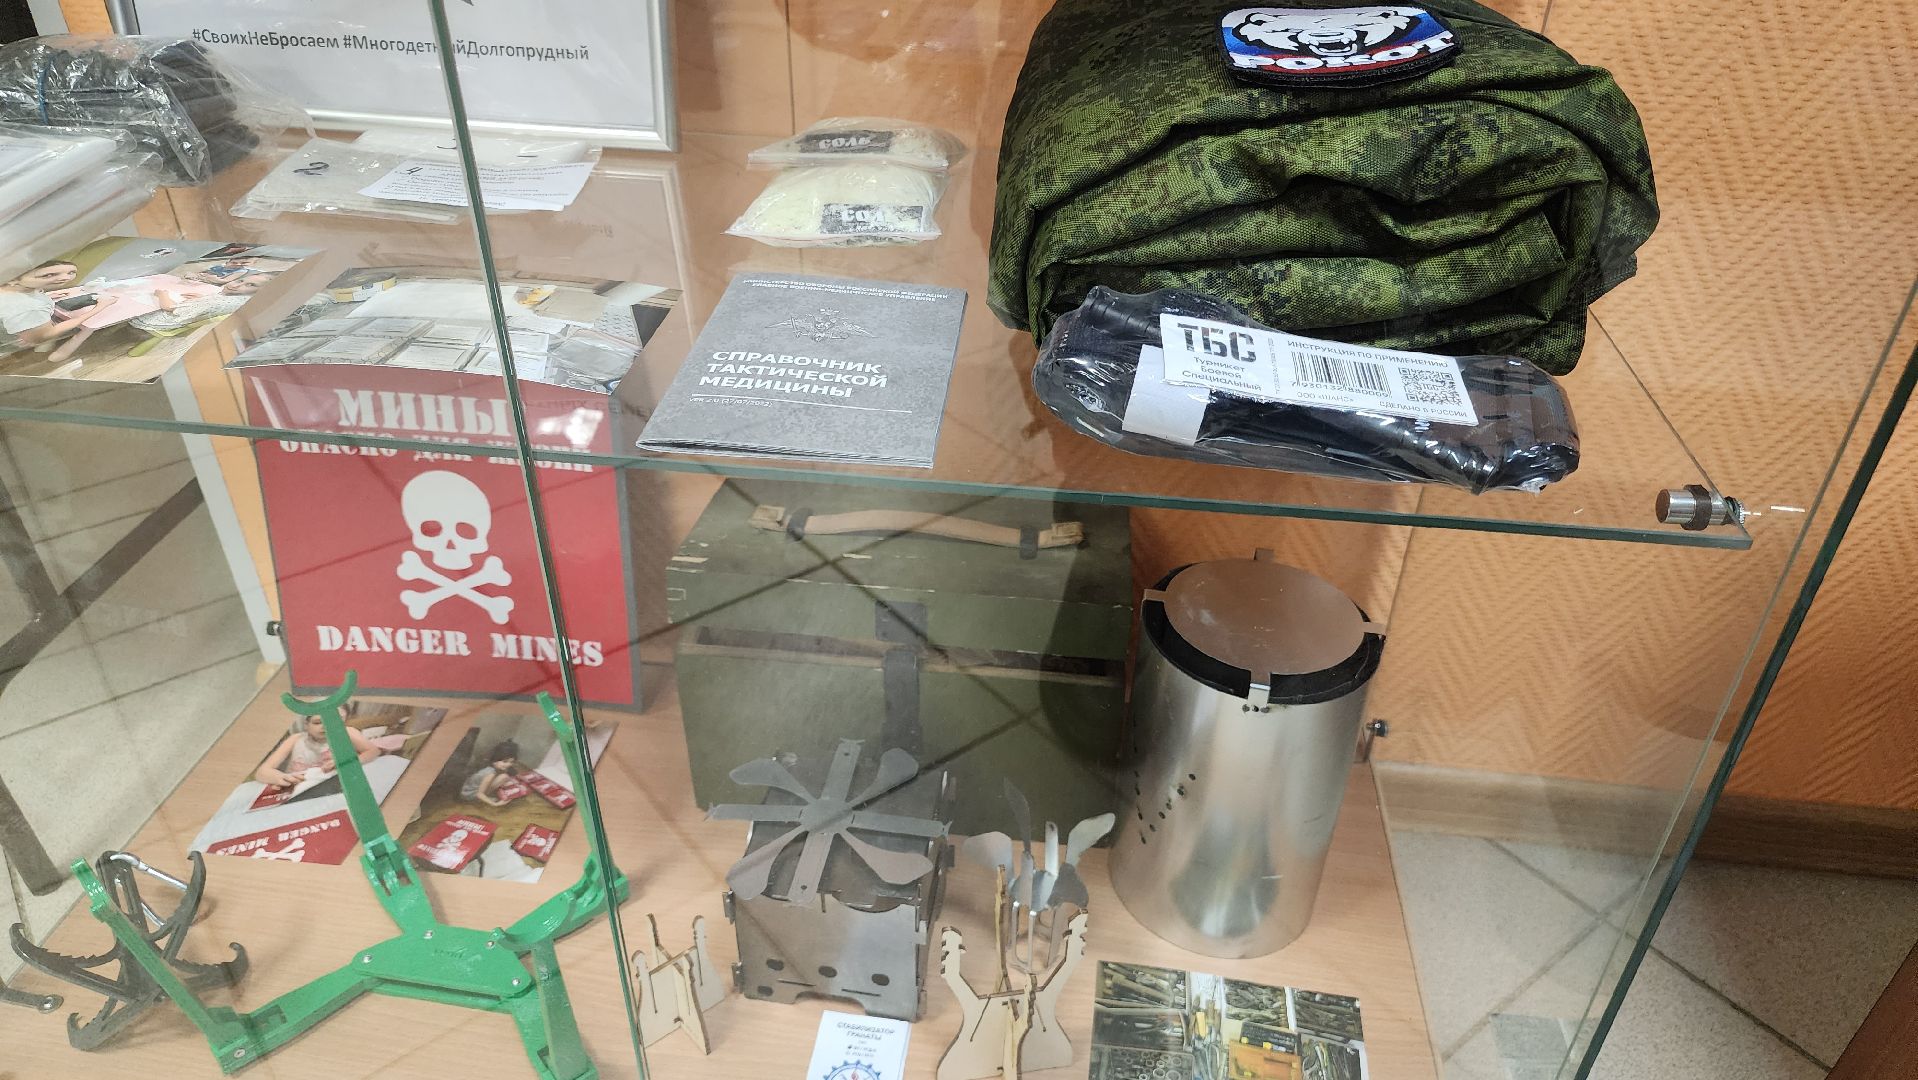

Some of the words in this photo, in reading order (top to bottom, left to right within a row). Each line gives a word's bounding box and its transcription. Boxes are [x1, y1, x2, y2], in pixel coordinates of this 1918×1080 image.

[192, 28, 340, 49] #СвоихНеБросаем
[817, 136, 872, 150] СОЛЬ
[847, 285, 899, 294] РОССИЙСКОЙ
[900, 291, 948, 299] ФЕДЕРАЦИИ
[885, 293, 936, 302] УПРАВЛЕНИЕ
[1177, 322, 1257, 363] ТБС
[711, 351, 882, 374] СПРАВОЧНИК
[1193, 356, 1246, 372] Турникет
[1287, 340, 1356, 357] ИНСТРУКЦИЯ
[1374, 353, 1448, 368] ПРИМЕНЕНИЮ
[706, 363, 889, 388] ТАКТИЧЕСКОЙ
[1182, 370, 1262, 391] Специальный
[1200, 365, 1242, 379] Боевой
[699, 376, 853, 398] МЕДИЦИНЫ
[333, 388, 512, 437] МИНЫ
[1379, 401, 1421, 412] СДЕЛАНО
[1430, 408, 1467, 417] РОССИИ
[316, 625, 471, 656] DANGER
[490, 632, 604, 667] MINES
